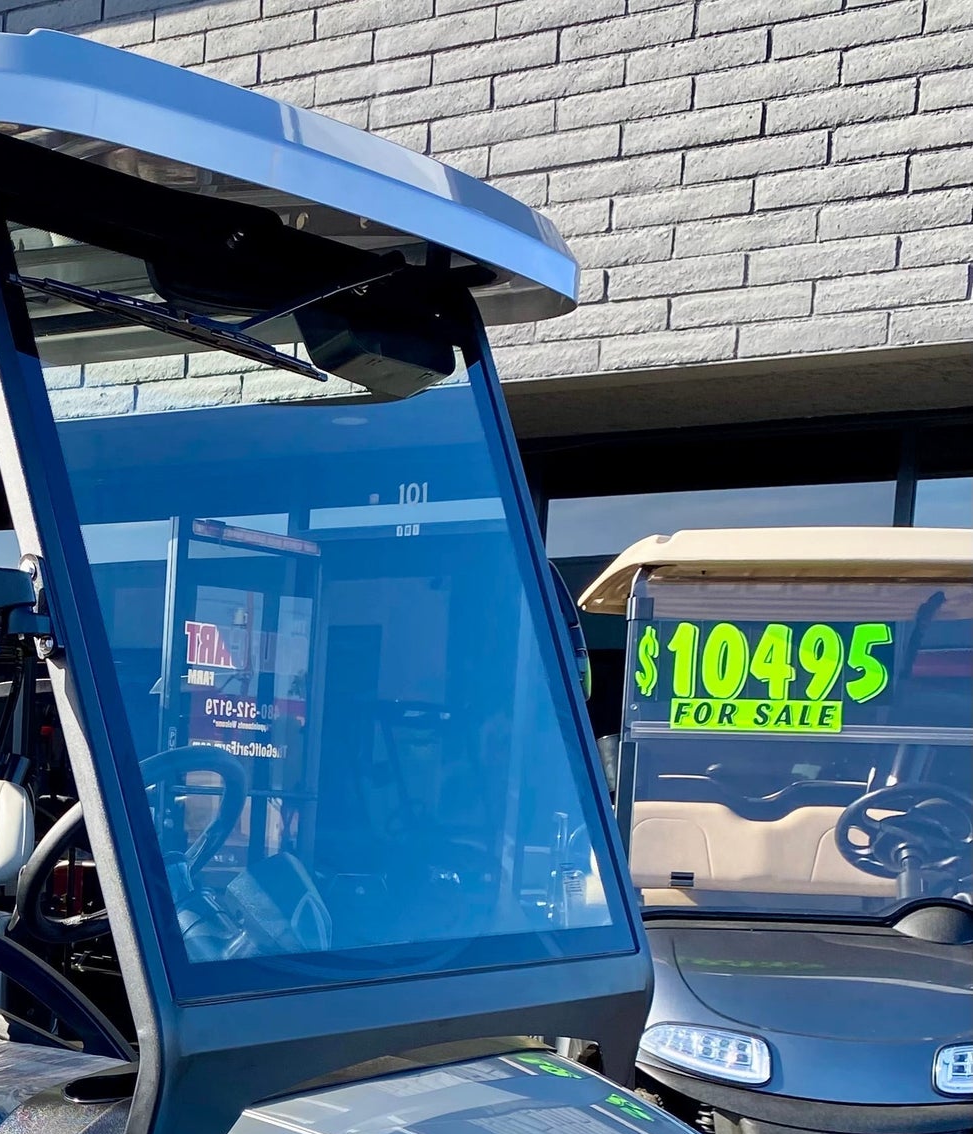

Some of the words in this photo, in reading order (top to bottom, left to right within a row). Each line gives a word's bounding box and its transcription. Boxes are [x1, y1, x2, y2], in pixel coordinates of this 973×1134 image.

[398, 481, 428, 507] 101
[635, 622, 893, 704] $10495
[673, 702, 741, 727] FOR
[753, 703, 838, 728] SALE
